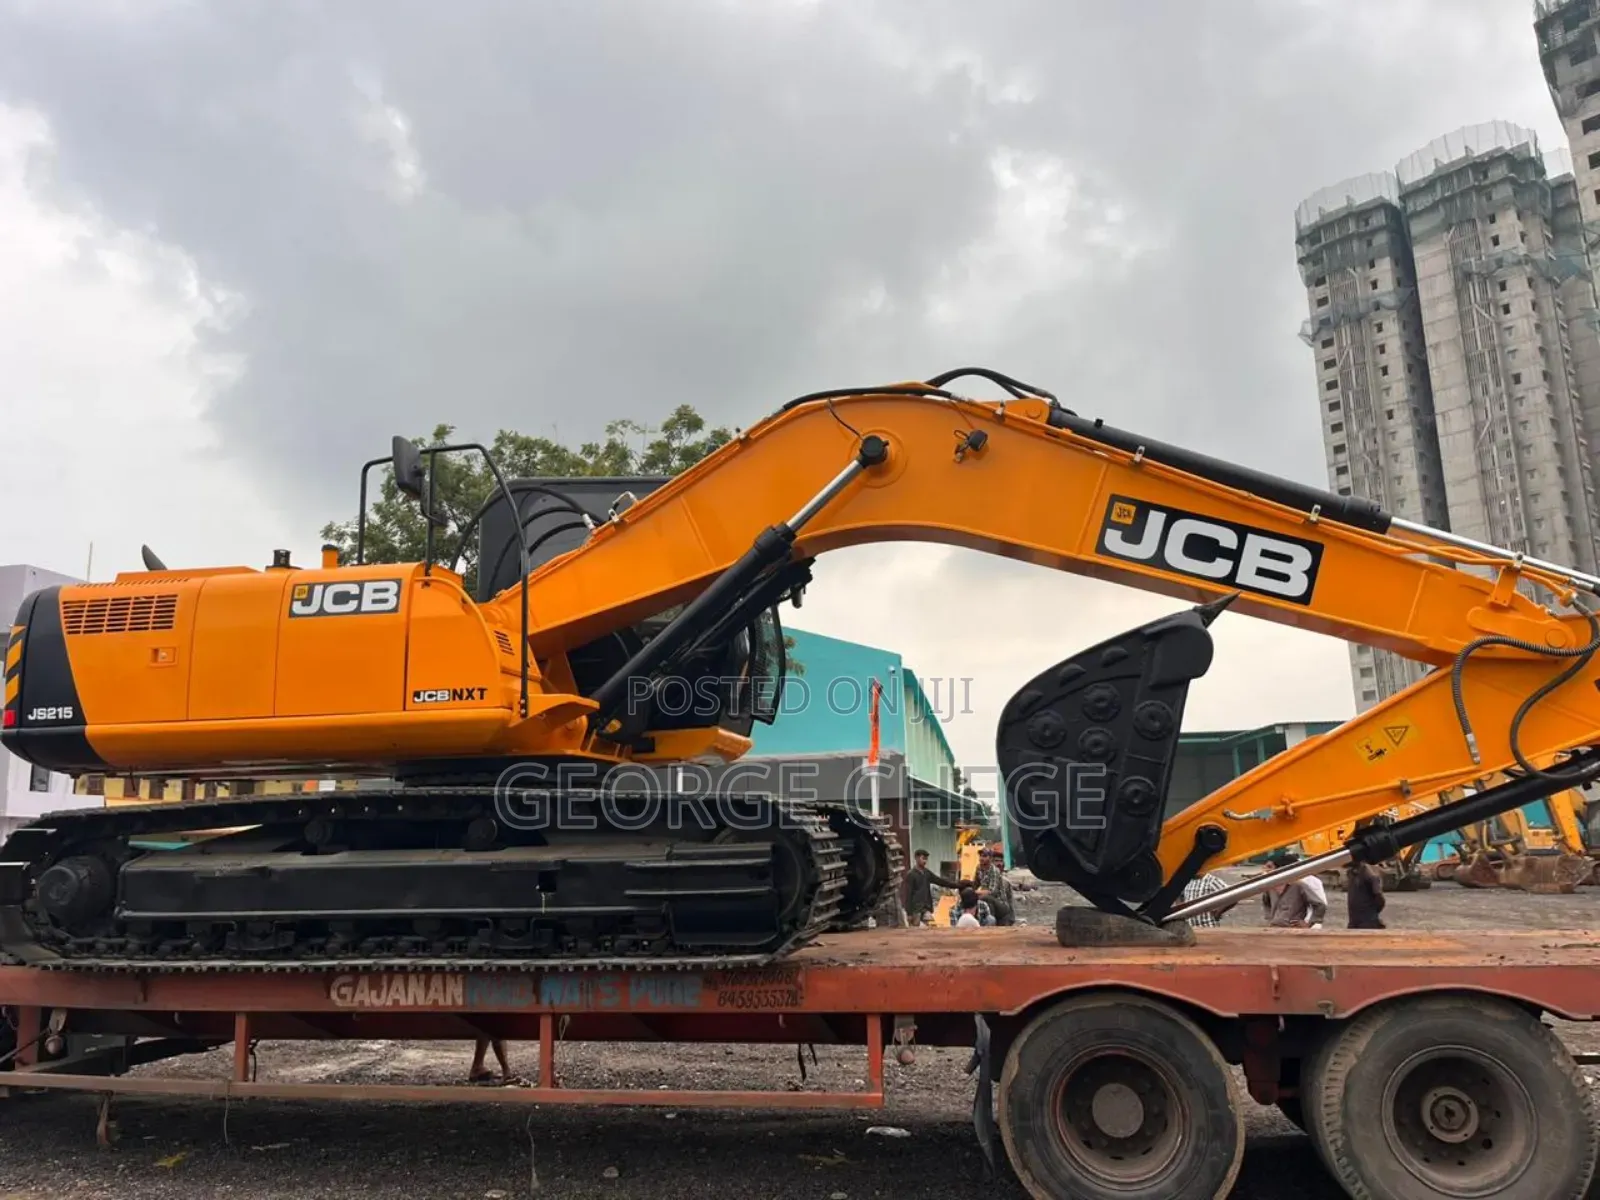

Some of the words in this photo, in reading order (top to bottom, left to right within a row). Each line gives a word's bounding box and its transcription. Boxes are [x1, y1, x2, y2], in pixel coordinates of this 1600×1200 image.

[1104, 509, 1312, 598] JCB
[291, 580, 399, 615] JCB
[28, 706, 73, 720] JS215
[413, 690, 450, 703] JCB
[452, 688, 488, 701] NXT
[329, 973, 465, 1008] GAJANAN
